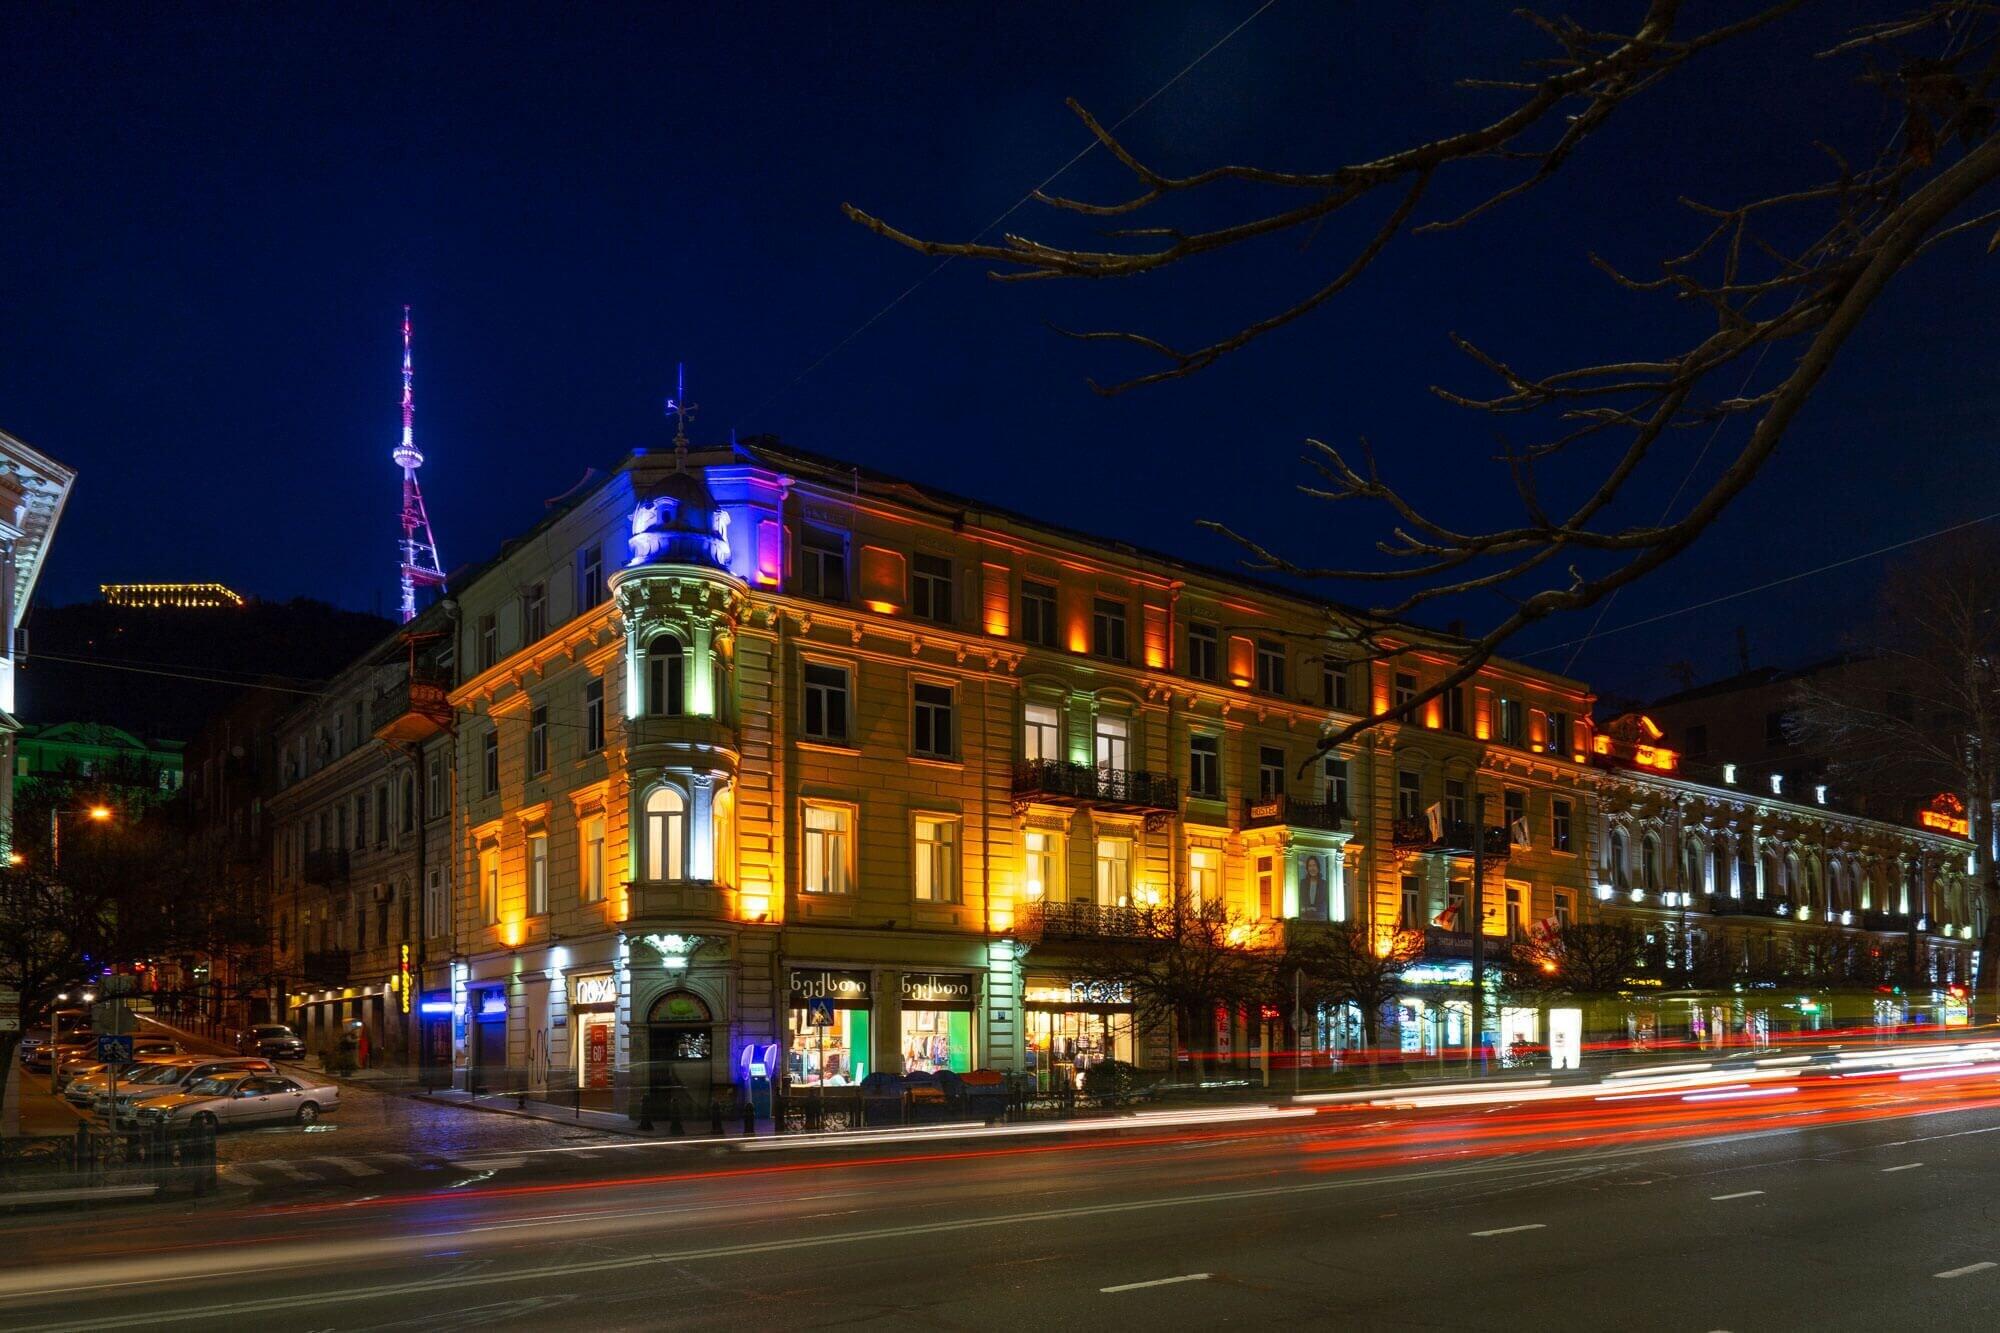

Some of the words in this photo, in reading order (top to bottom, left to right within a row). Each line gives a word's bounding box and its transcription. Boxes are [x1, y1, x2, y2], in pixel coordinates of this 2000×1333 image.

[791, 972, 866, 998] ნექსთი
[901, 975, 968, 1000] ნექსთი
[1072, 981, 1132, 1003] next
